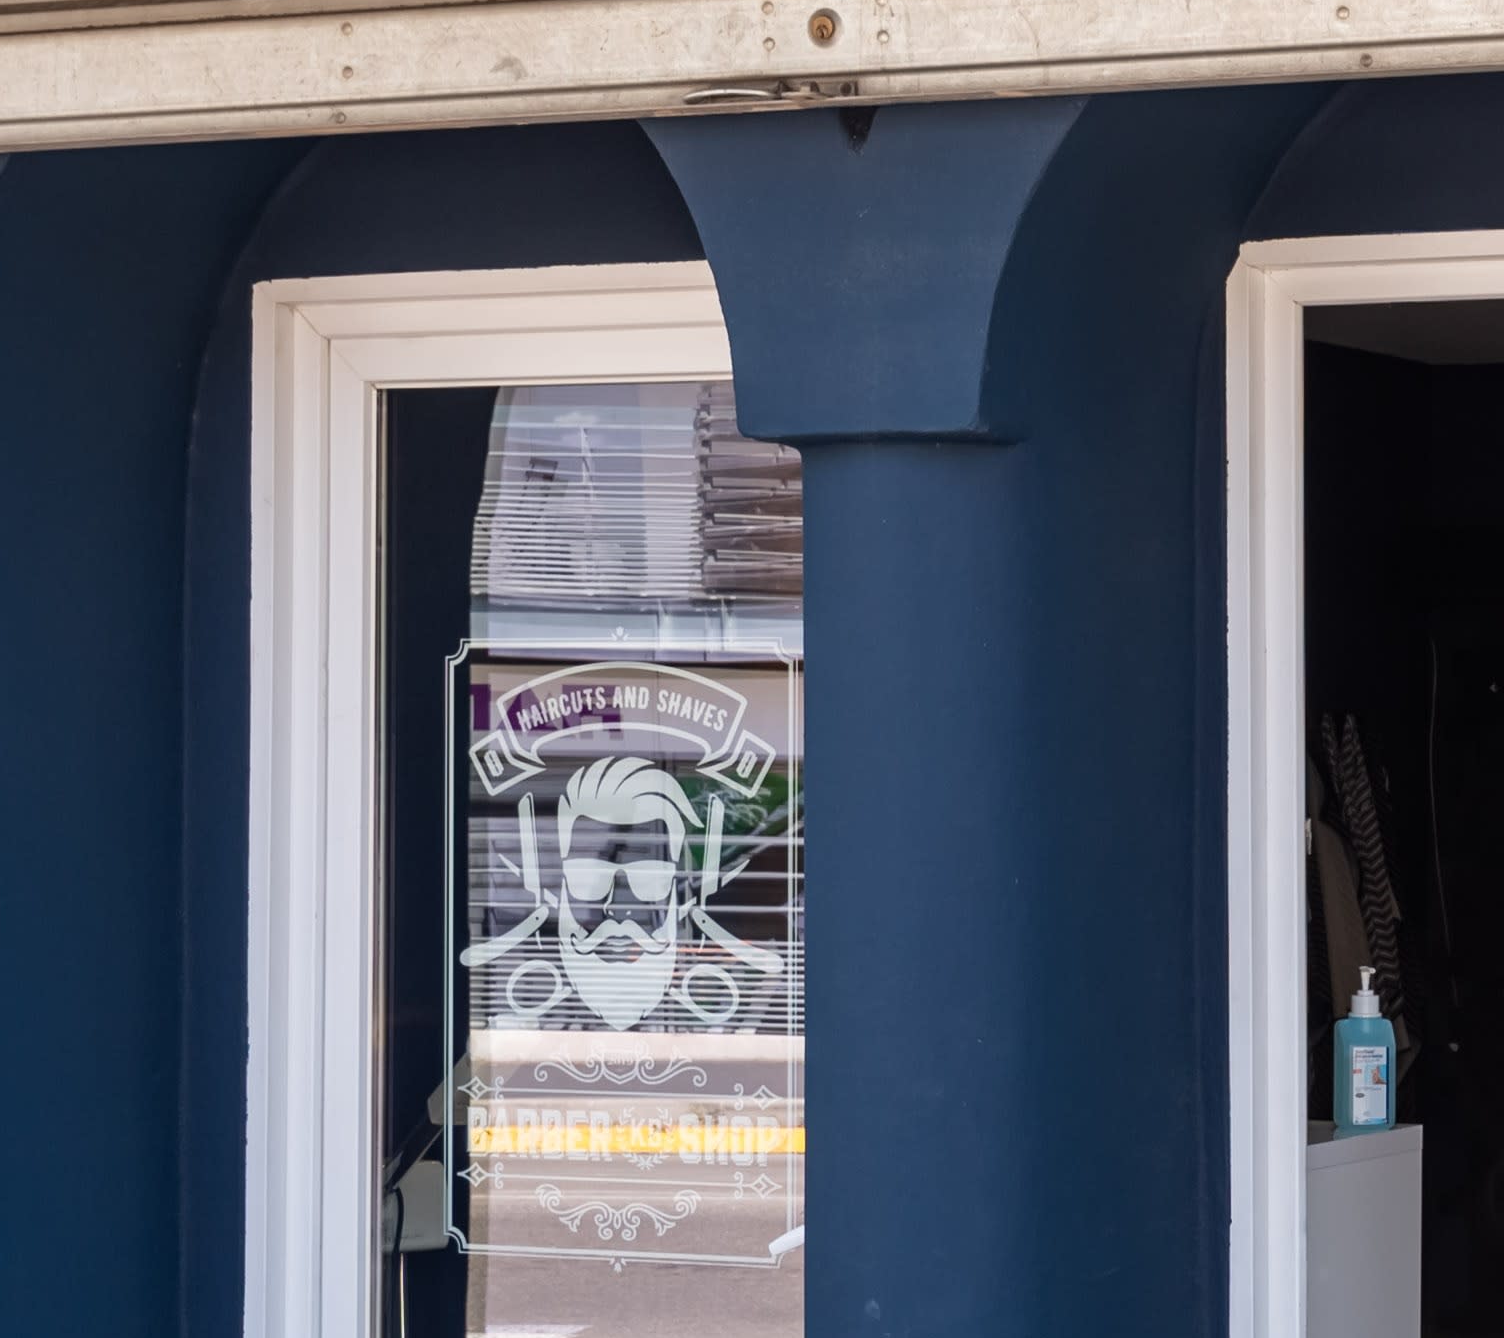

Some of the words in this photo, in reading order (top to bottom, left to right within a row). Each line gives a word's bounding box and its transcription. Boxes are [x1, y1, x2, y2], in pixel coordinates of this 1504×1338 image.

[517, 687, 606, 733] HAIRCUTS
[612, 686, 650, 711] AND
[657, 689, 729, 732] SHAVES
[466, 1105, 613, 1161] BARBER
[678, 1113, 782, 1167] SHOP
